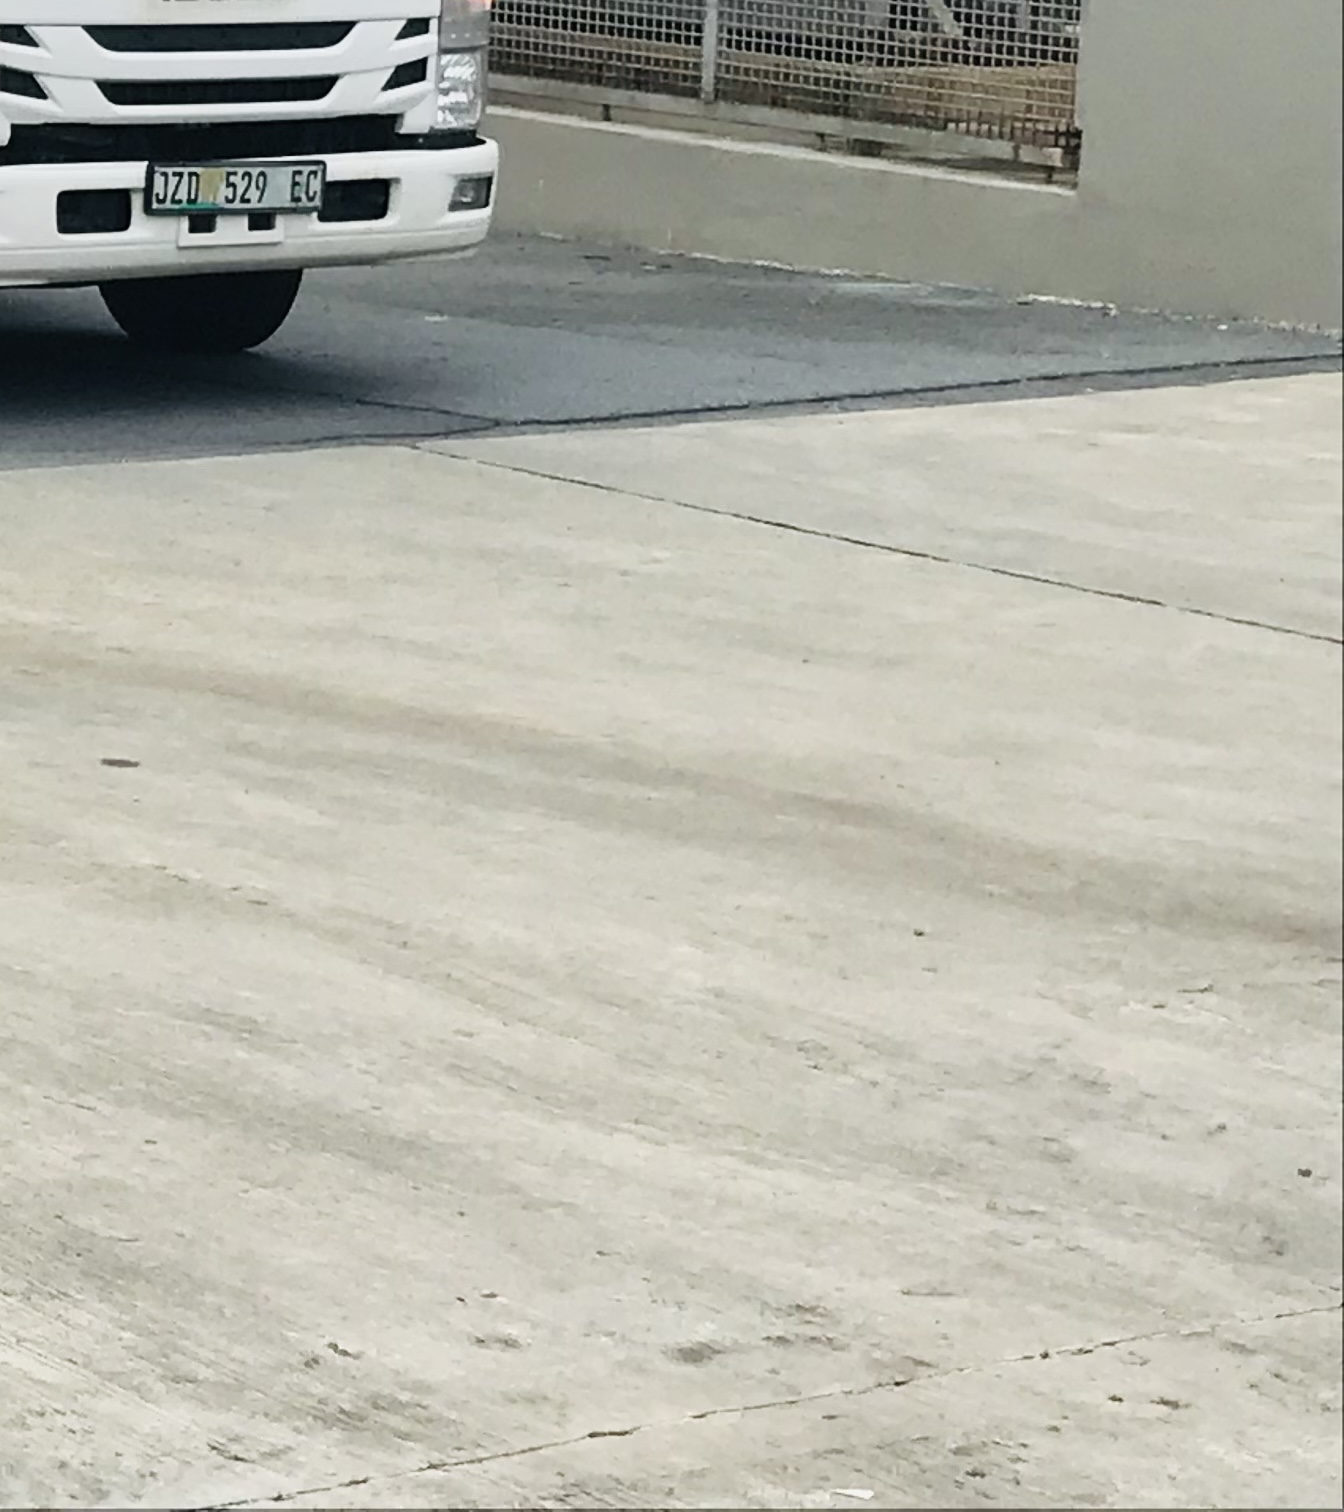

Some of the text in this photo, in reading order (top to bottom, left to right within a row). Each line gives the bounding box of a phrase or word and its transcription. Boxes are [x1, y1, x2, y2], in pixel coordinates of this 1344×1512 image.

[155, 169, 318, 205] JZD 529 EC
